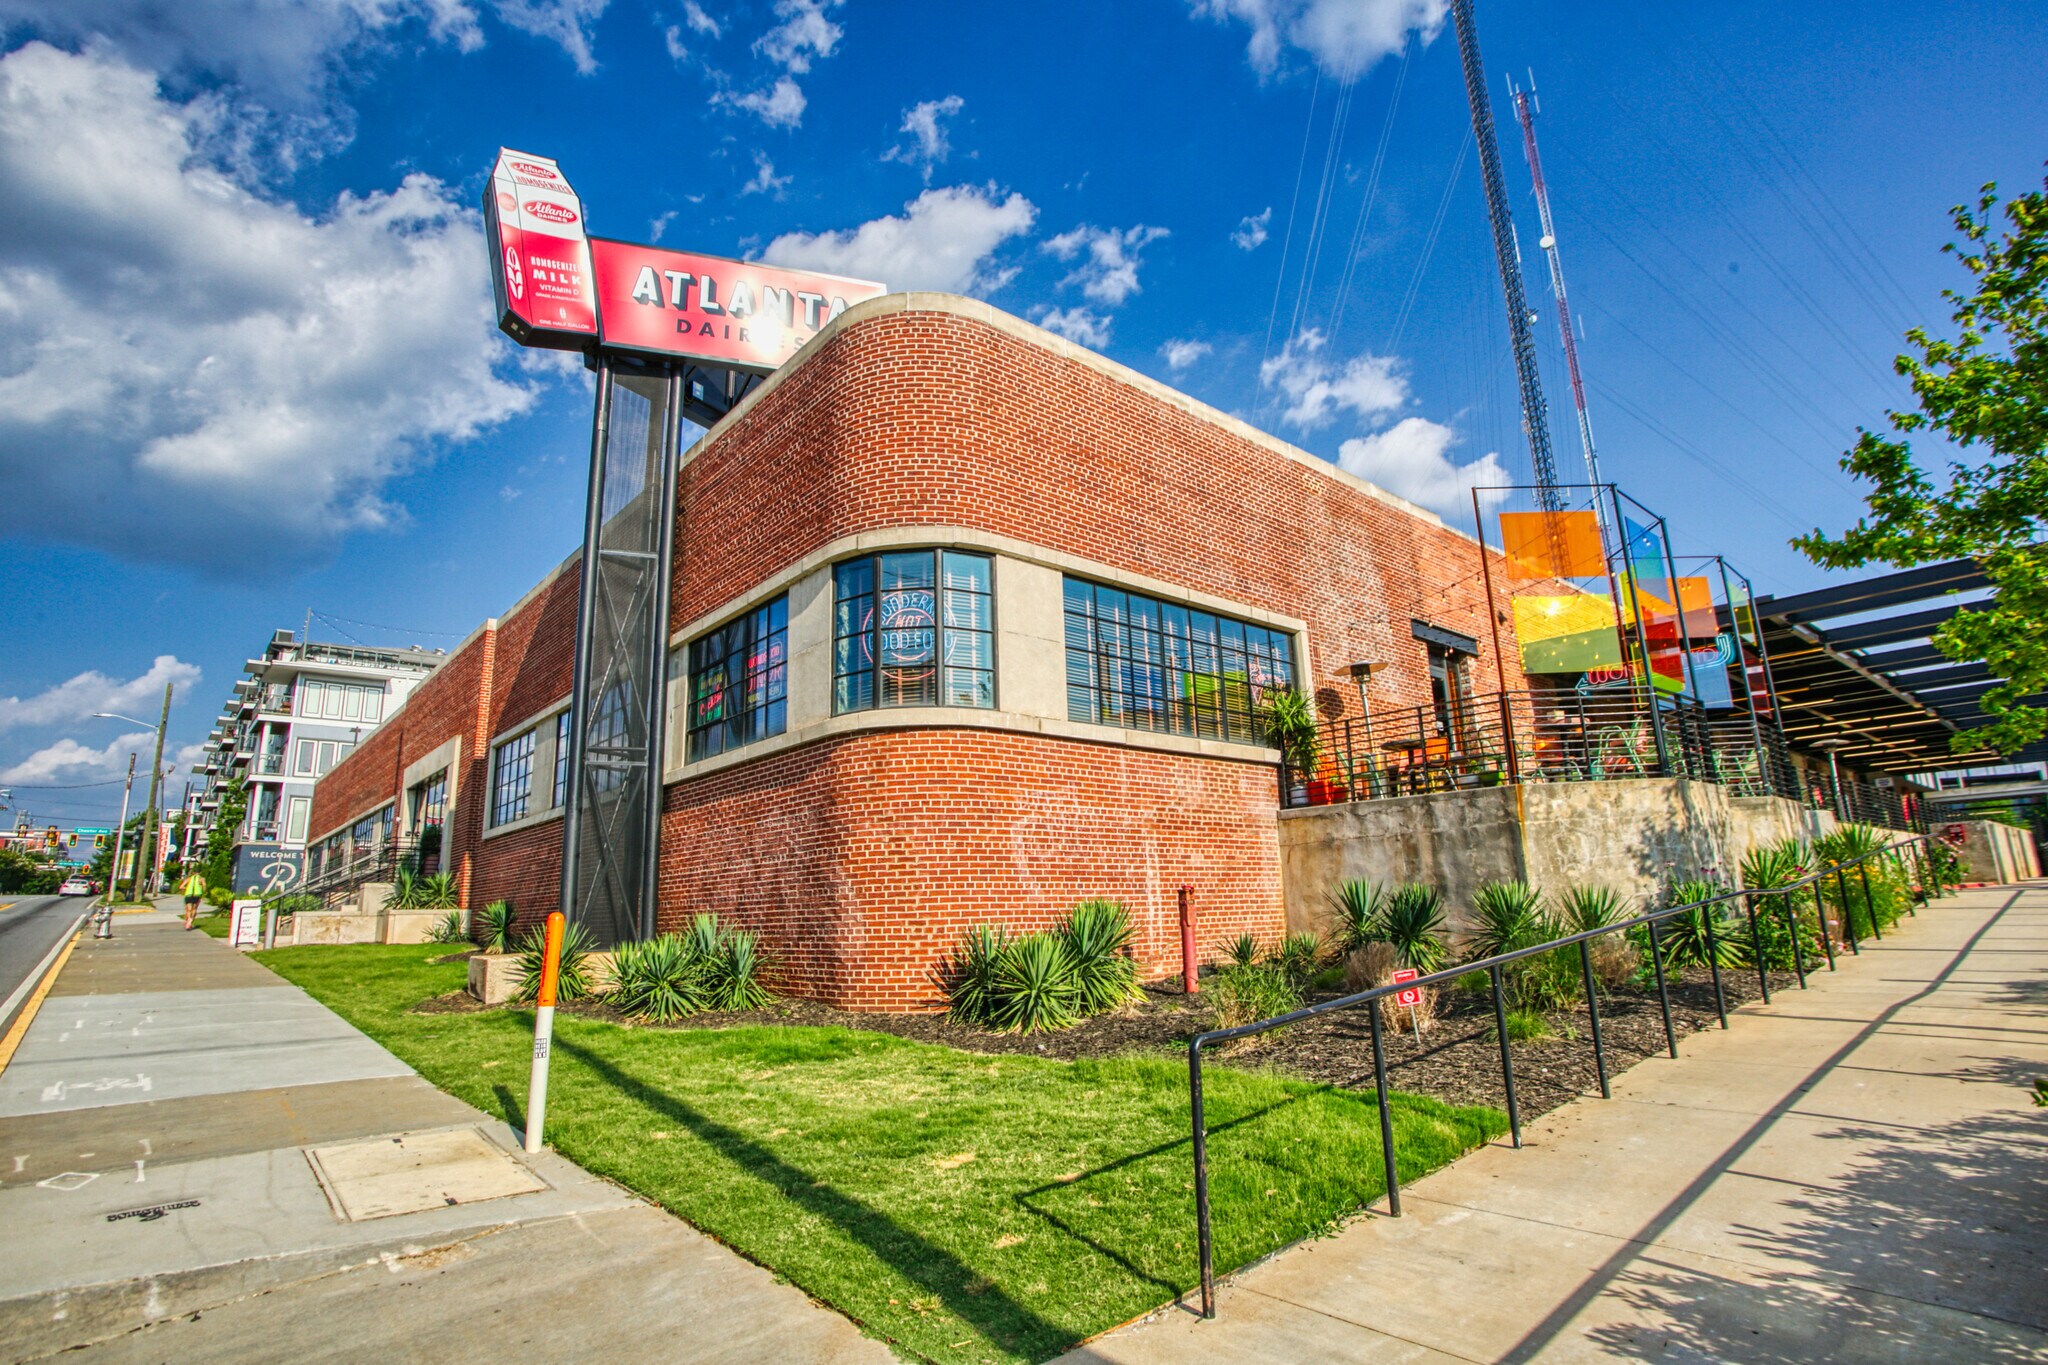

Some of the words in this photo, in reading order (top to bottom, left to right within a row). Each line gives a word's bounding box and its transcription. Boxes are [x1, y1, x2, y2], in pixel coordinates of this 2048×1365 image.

[514, 163, 554, 177] Atlanta
[527, 201, 574, 218] Atlanta
[537, 212, 568, 223] DAIRIES
[532, 269, 582, 285] MILK
[539, 283, 572, 295] VITAMIN
[631, 264, 850, 331] ATLANTA
[539, 318, 552, 326] ONE
[567, 322, 590, 330] GALLON
[676, 318, 804, 350] DAIRES
[894, 614, 925, 632] HOT
[914, 631, 953, 650] FOD
[250, 851, 297, 859] WELCOME
